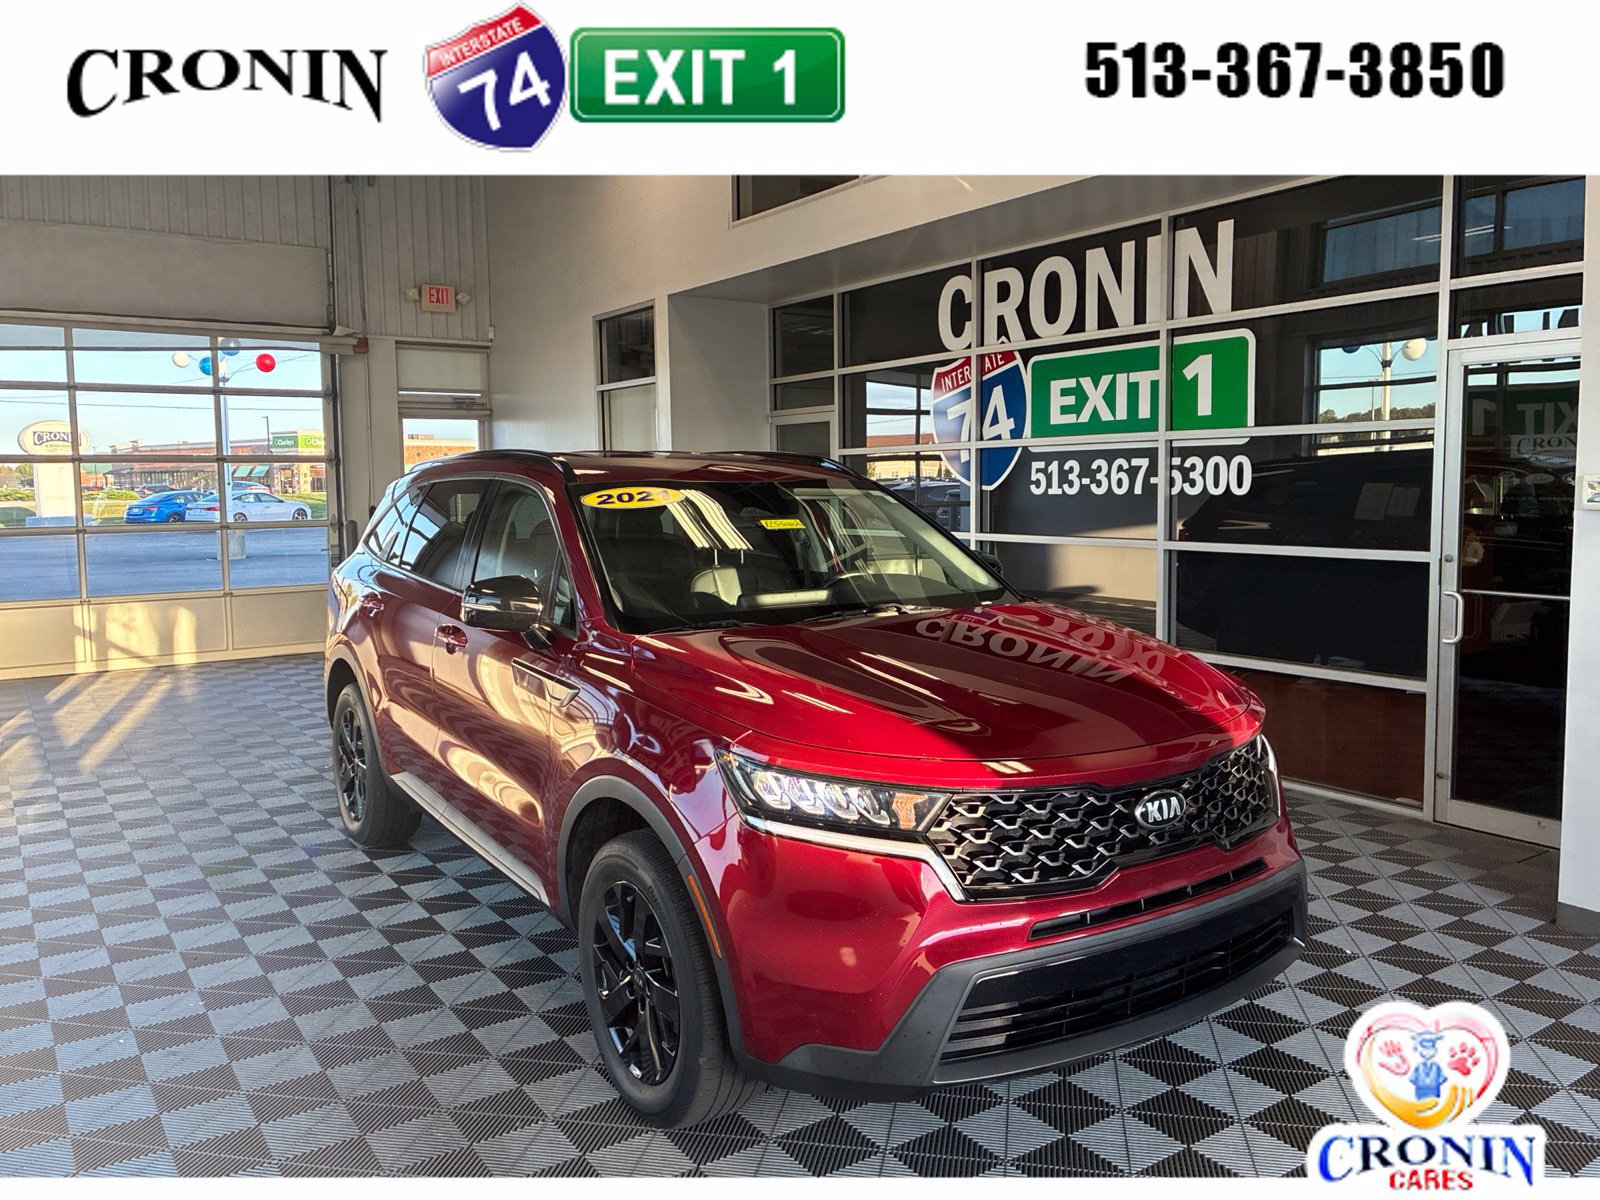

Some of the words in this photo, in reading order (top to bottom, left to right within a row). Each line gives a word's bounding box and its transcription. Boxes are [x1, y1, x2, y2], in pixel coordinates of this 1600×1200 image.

[428, 287, 449, 304] EXIT
[938, 219, 1235, 351] CRONIN
[941, 353, 1005, 393] INTERATE
[1050, 369, 1161, 425] EXIT
[1182, 354, 1213, 416] 1
[596, 490, 669, 505] 2021
[1146, 797, 1181, 822] KIA
